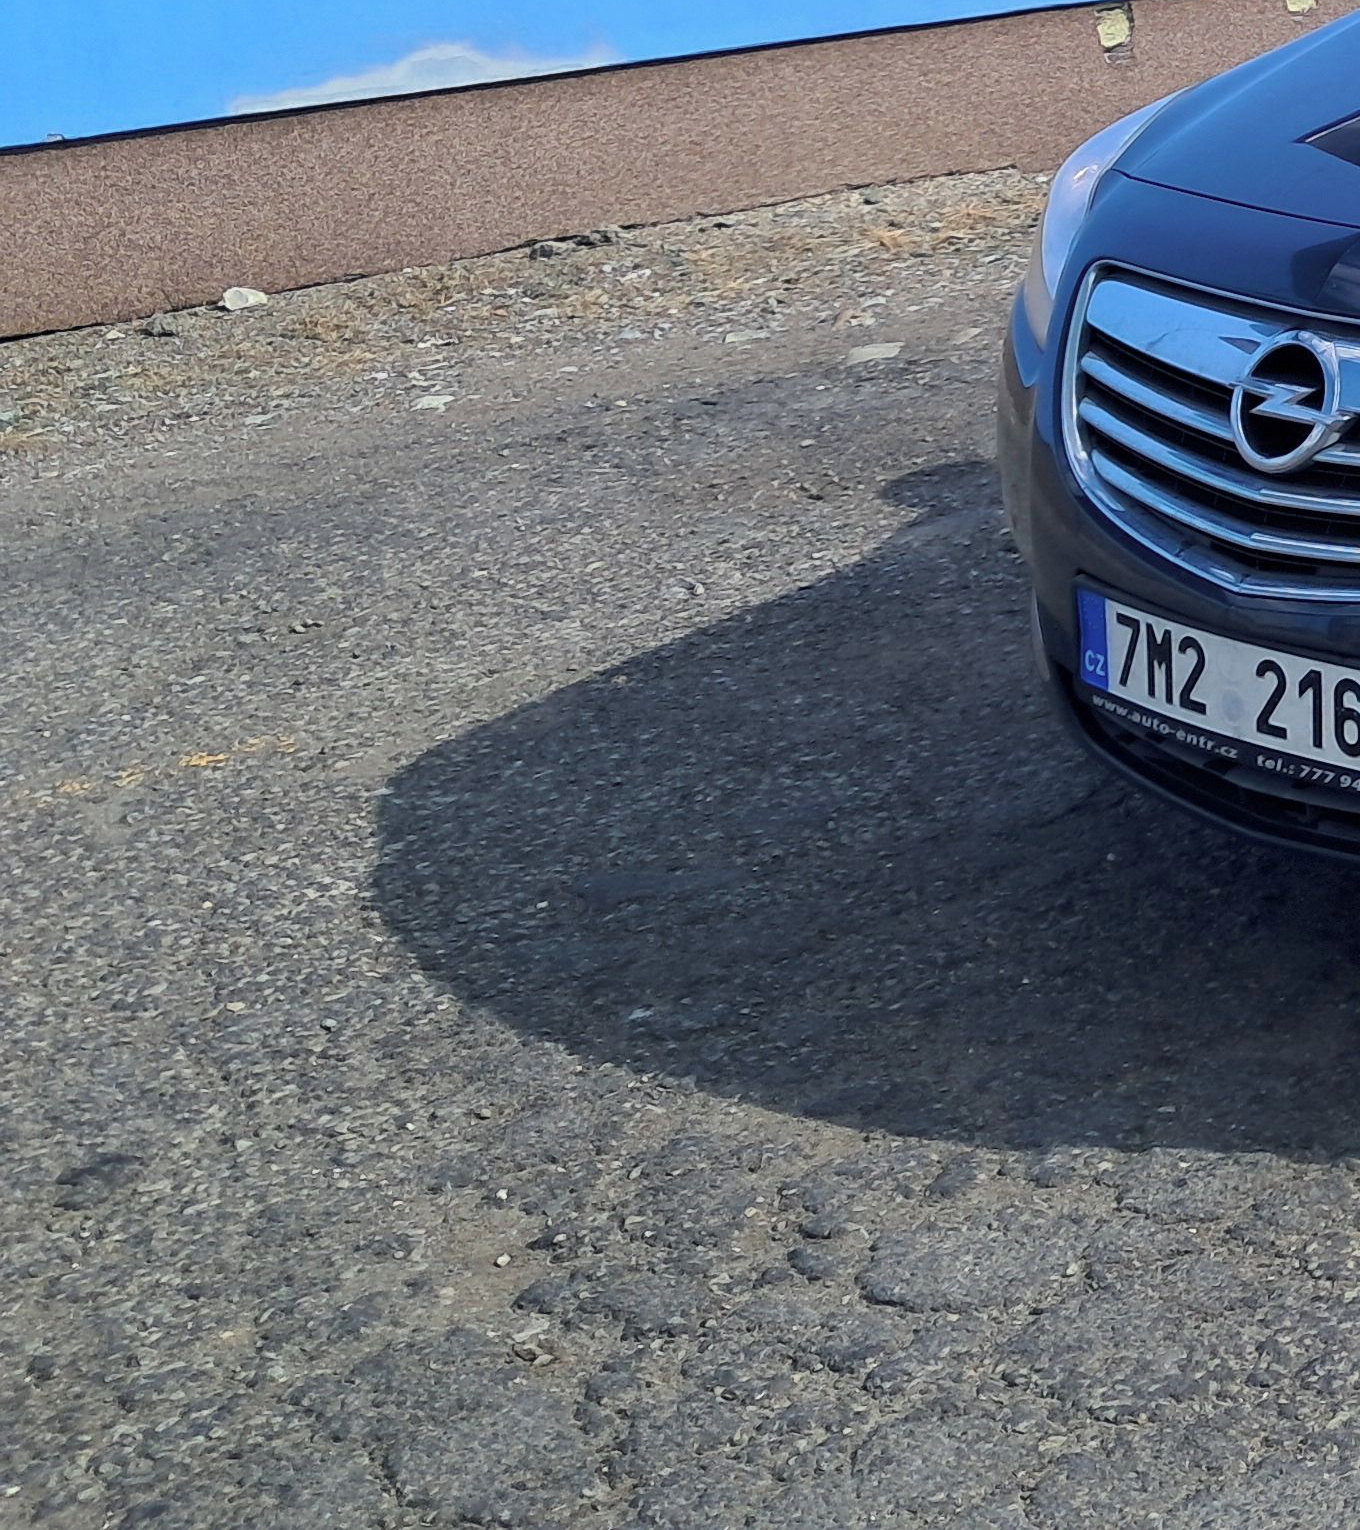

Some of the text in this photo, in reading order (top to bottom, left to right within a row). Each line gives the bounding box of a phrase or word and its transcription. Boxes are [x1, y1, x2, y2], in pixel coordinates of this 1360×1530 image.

[1085, 650, 1106, 676] CZ
[1115, 611, 1207, 715] 7M2
[1092, 694, 1239, 759] www.auto-entr.cz
[1257, 754, 1295, 775] tel.:
[1300, 765, 1335, 784] 777
